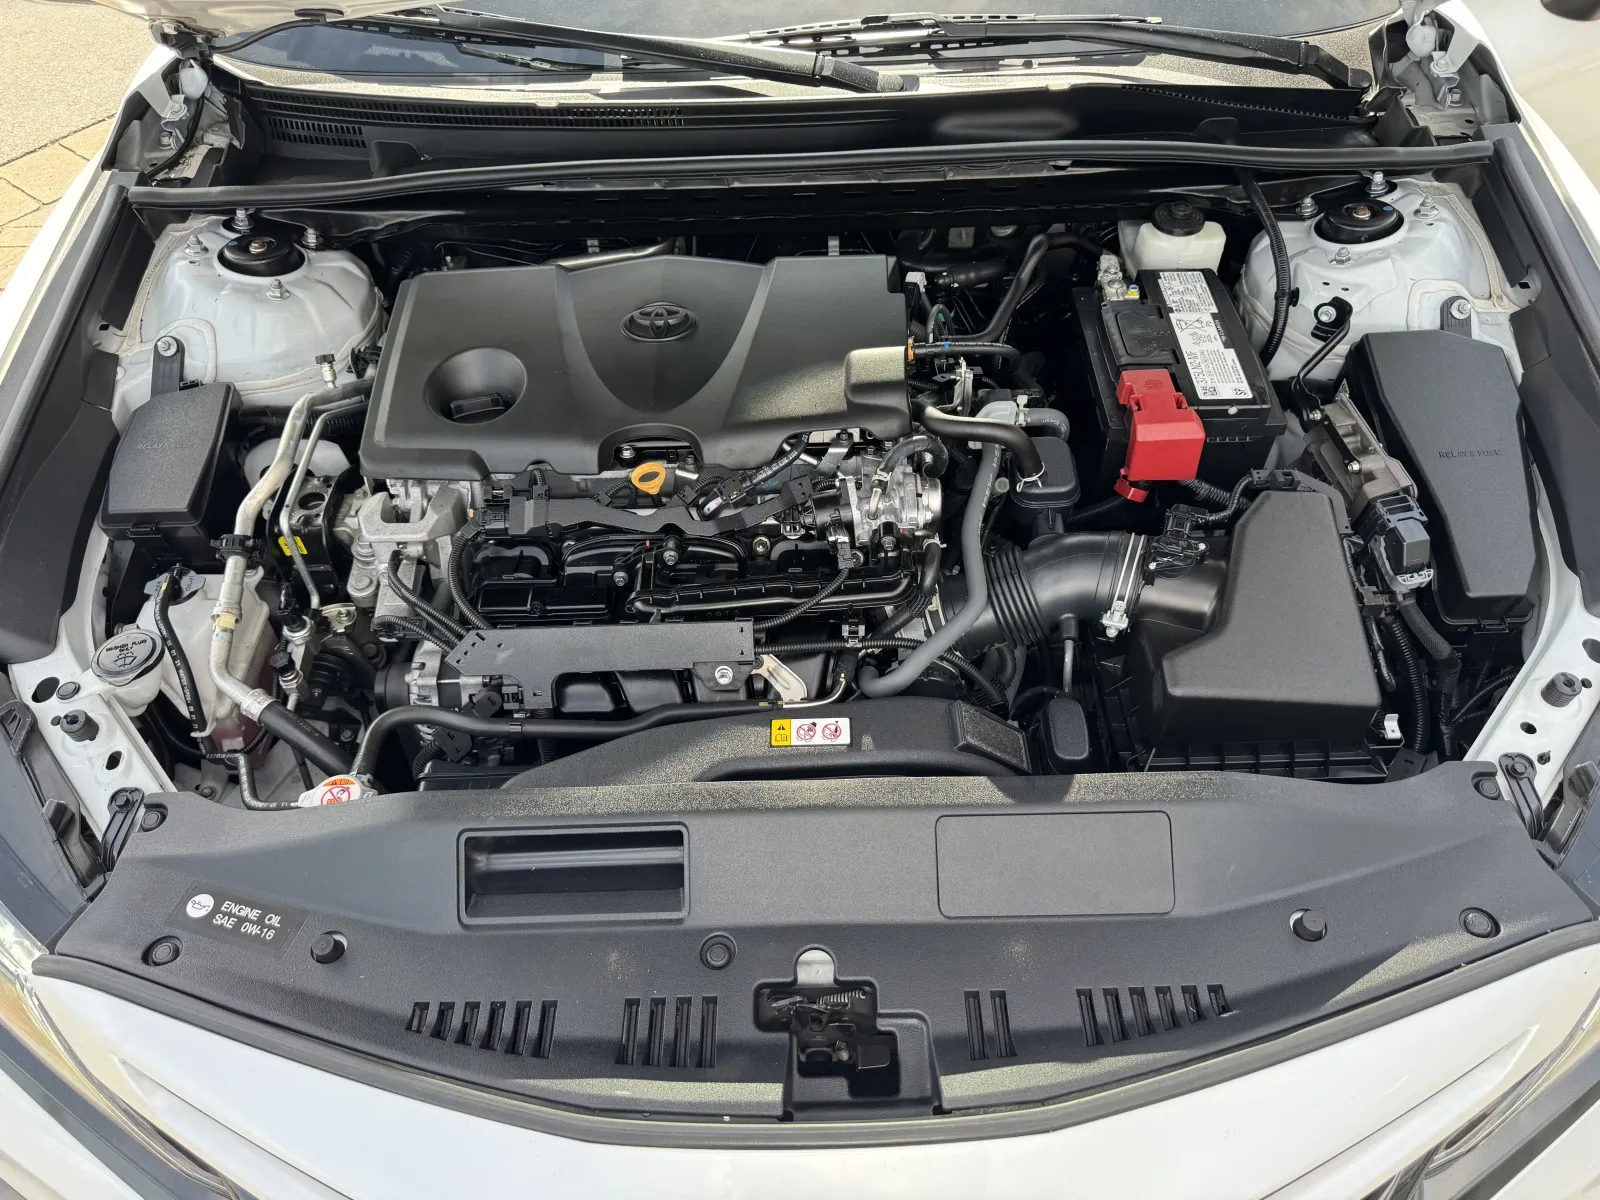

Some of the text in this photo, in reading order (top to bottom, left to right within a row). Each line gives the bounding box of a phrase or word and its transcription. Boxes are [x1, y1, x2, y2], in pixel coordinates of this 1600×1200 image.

[1438, 450, 1467, 459] RELAY
[1477, 449, 1502, 457] FUSE
[212, 913, 276, 940] SAE 0W-16
[220, 900, 281, 927] ENGINE OIL
